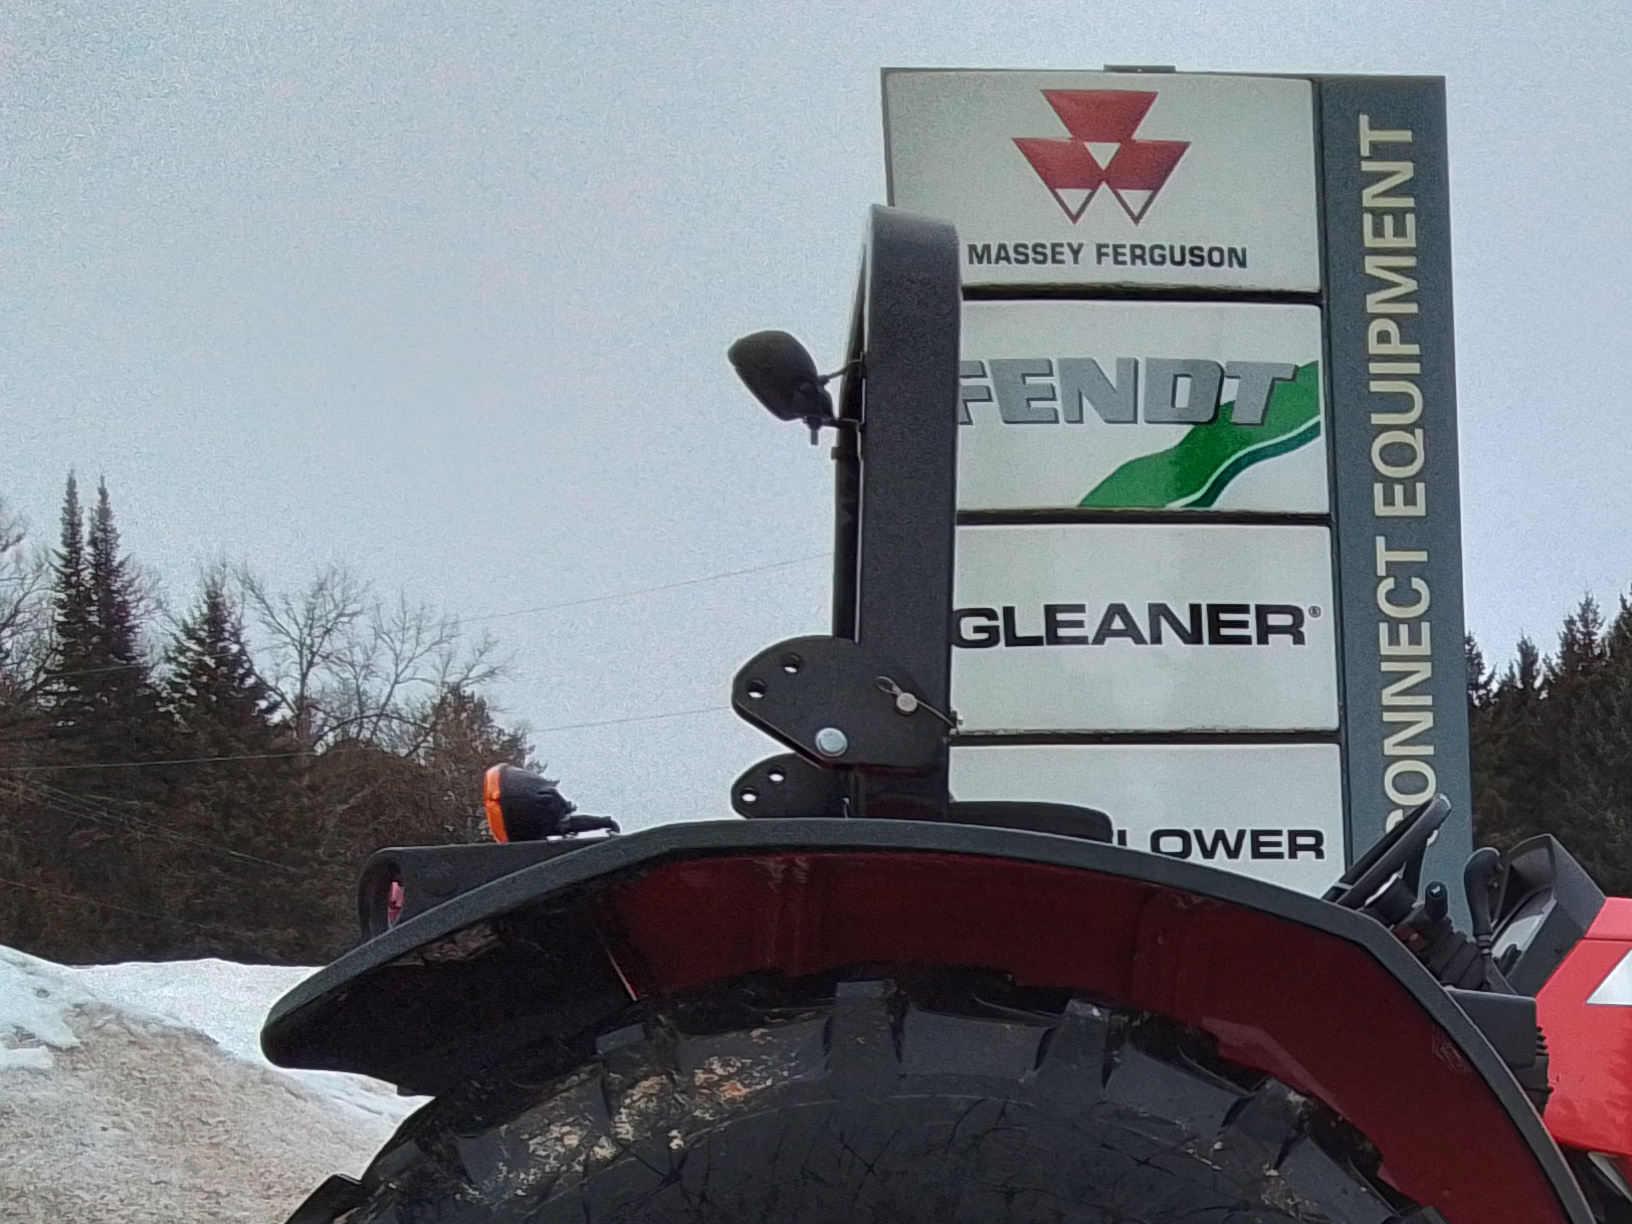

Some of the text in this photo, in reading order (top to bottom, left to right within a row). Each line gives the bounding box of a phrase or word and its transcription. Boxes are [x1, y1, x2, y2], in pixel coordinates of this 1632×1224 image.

[966, 242, 1248, 269] MASSEY FERGUSON
[1358, 112, 1438, 847] ONNECT EQUIPMENT
